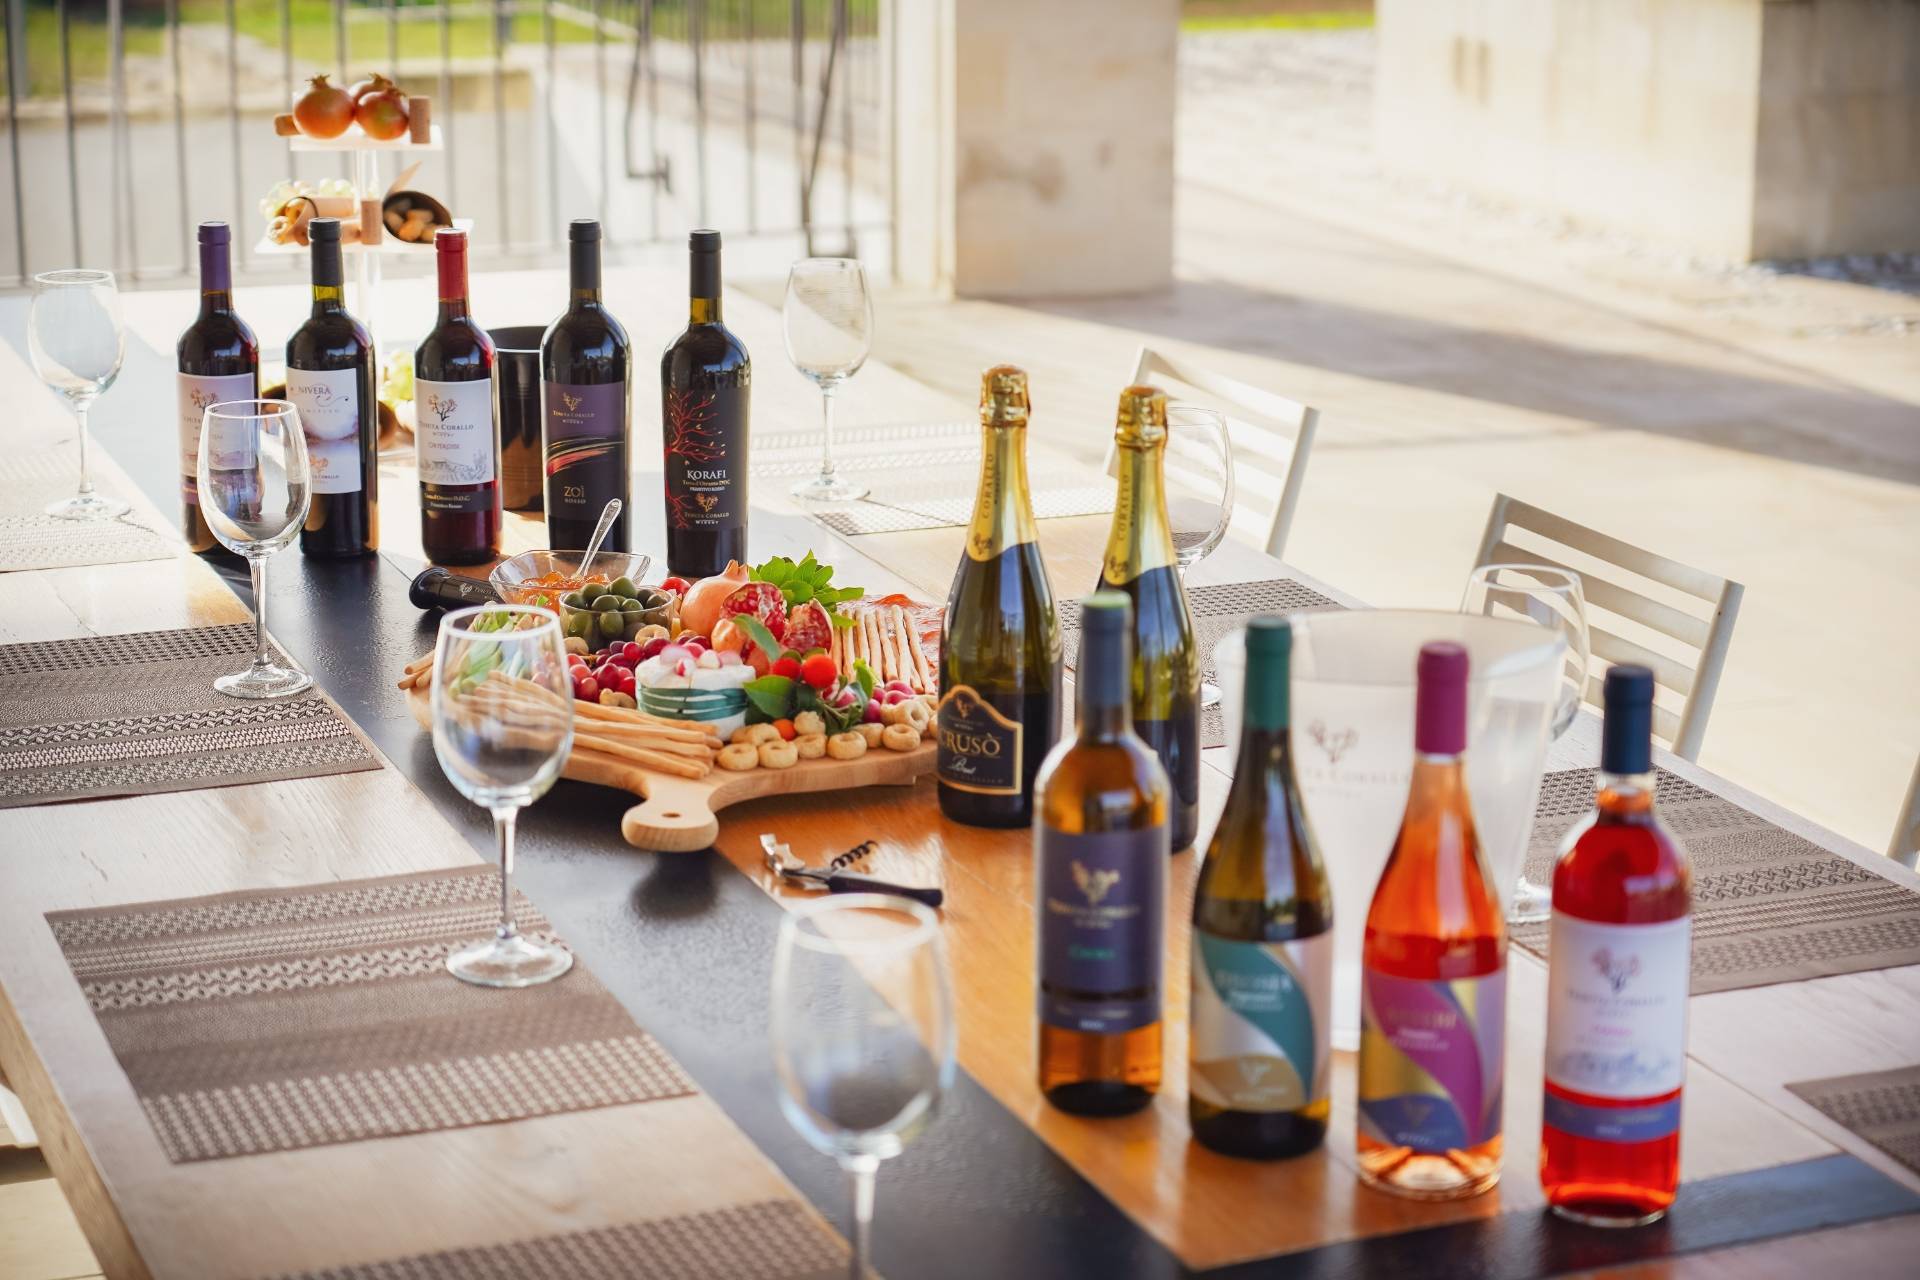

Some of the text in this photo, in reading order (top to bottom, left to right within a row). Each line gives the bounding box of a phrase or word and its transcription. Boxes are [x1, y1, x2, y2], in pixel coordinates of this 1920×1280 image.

[686, 469, 727, 481] KORAFI
[982, 453, 995, 519] CORALLO
[1115, 473, 1129, 542] CORALLO
